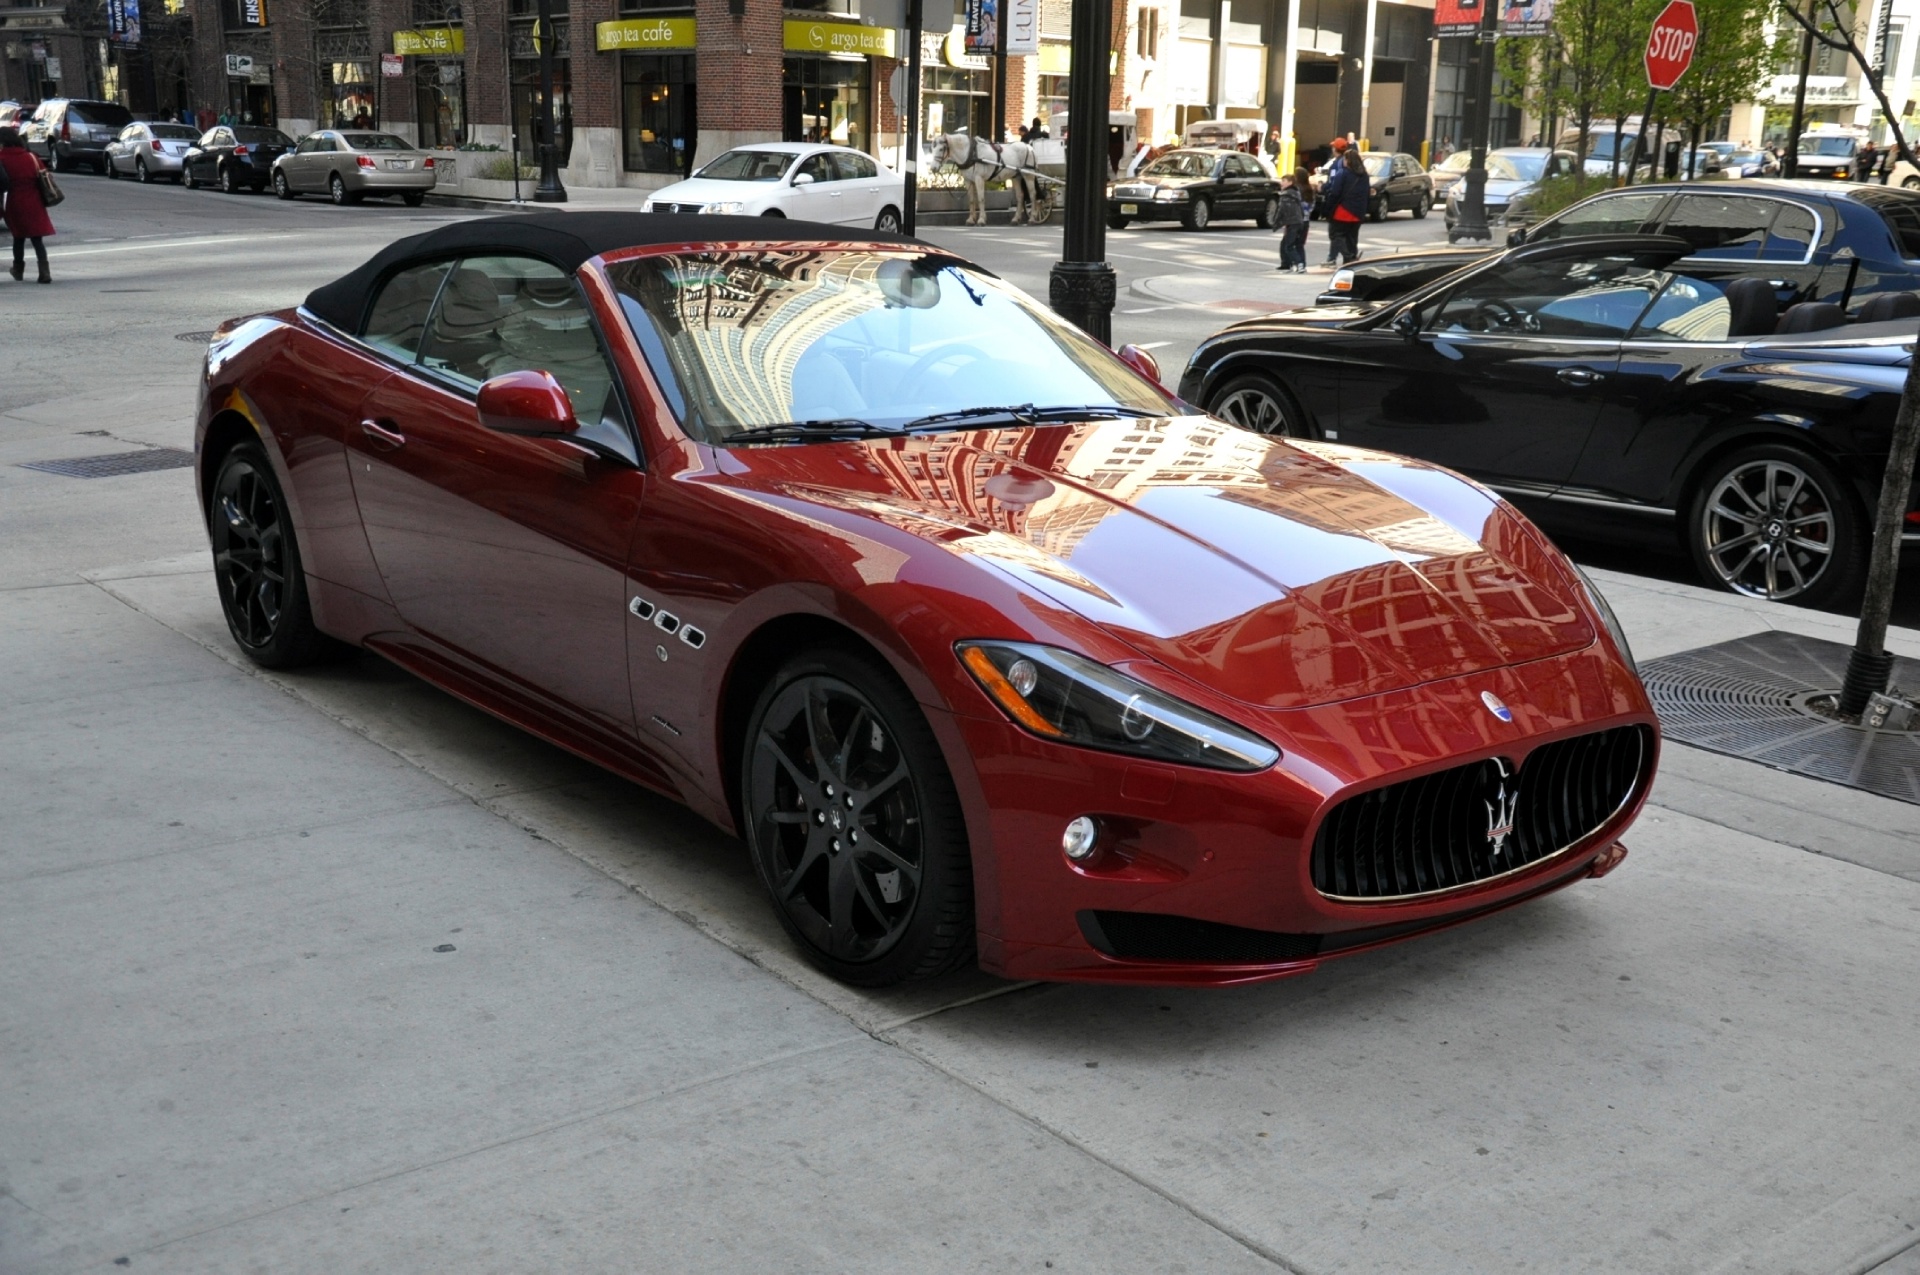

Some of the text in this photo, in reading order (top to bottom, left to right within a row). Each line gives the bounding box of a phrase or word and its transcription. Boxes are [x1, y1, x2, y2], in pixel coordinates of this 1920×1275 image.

[605, 20, 672, 47] argo tea café
[831, 33, 858, 50] argo
[860, 32, 874, 48] tea
[1650, 26, 1694, 62] STOP
